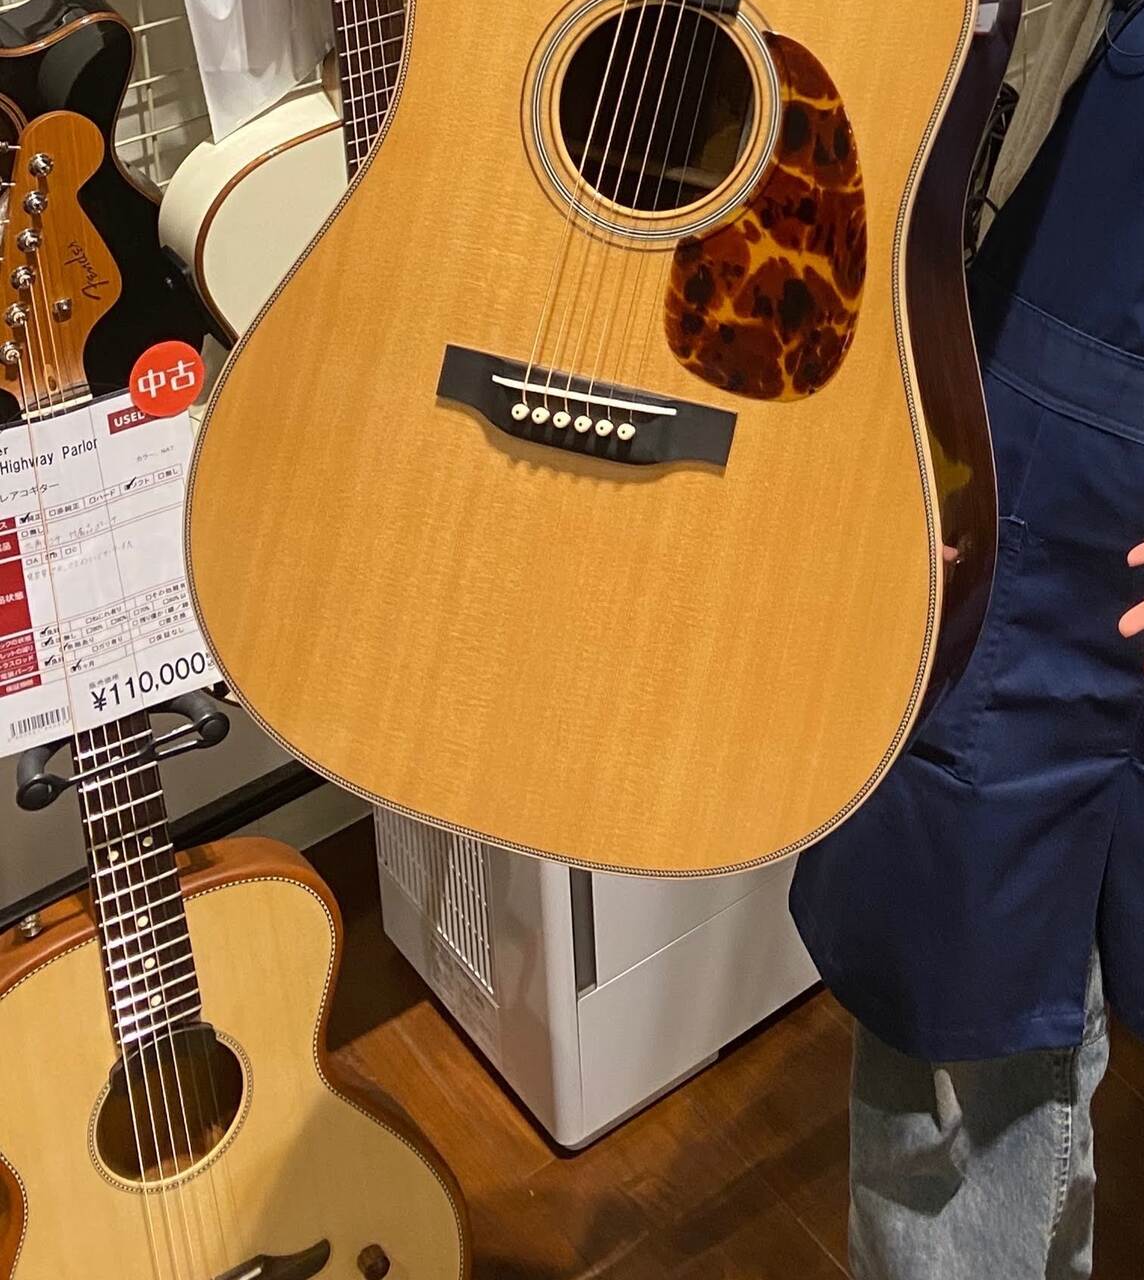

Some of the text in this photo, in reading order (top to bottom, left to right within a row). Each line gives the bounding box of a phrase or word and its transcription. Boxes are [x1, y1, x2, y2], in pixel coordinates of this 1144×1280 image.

[64, 240, 110, 300] Fender
[137, 360, 196, 399] 中古
[0, 438, 98, 475] Highway Parlor
[0, 482, 59, 503] レアコギター
[0, 654, 34, 669] ラスロッド
[91, 652, 206, 711] ¥110,000
